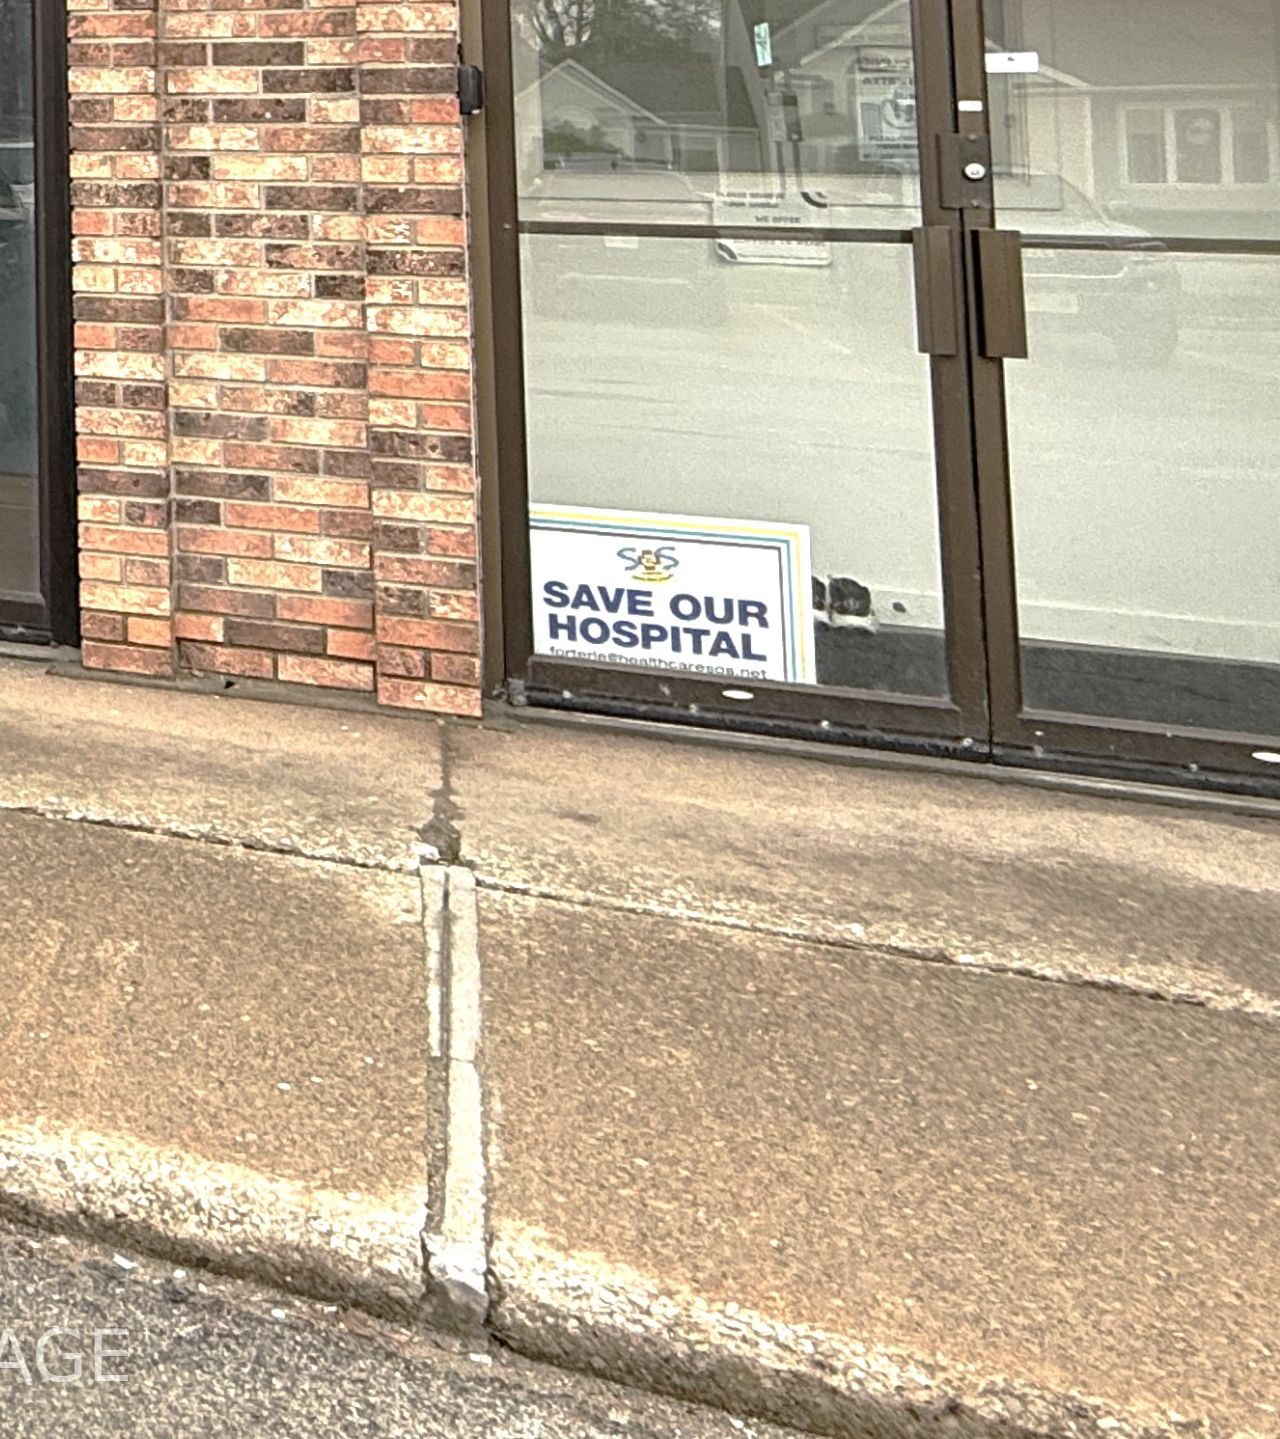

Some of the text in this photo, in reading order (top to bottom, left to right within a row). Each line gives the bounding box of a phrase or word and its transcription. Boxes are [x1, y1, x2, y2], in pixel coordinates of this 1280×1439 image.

[543, 581, 769, 628] SAVE OUR
[548, 613, 767, 661] HOSPITAL
